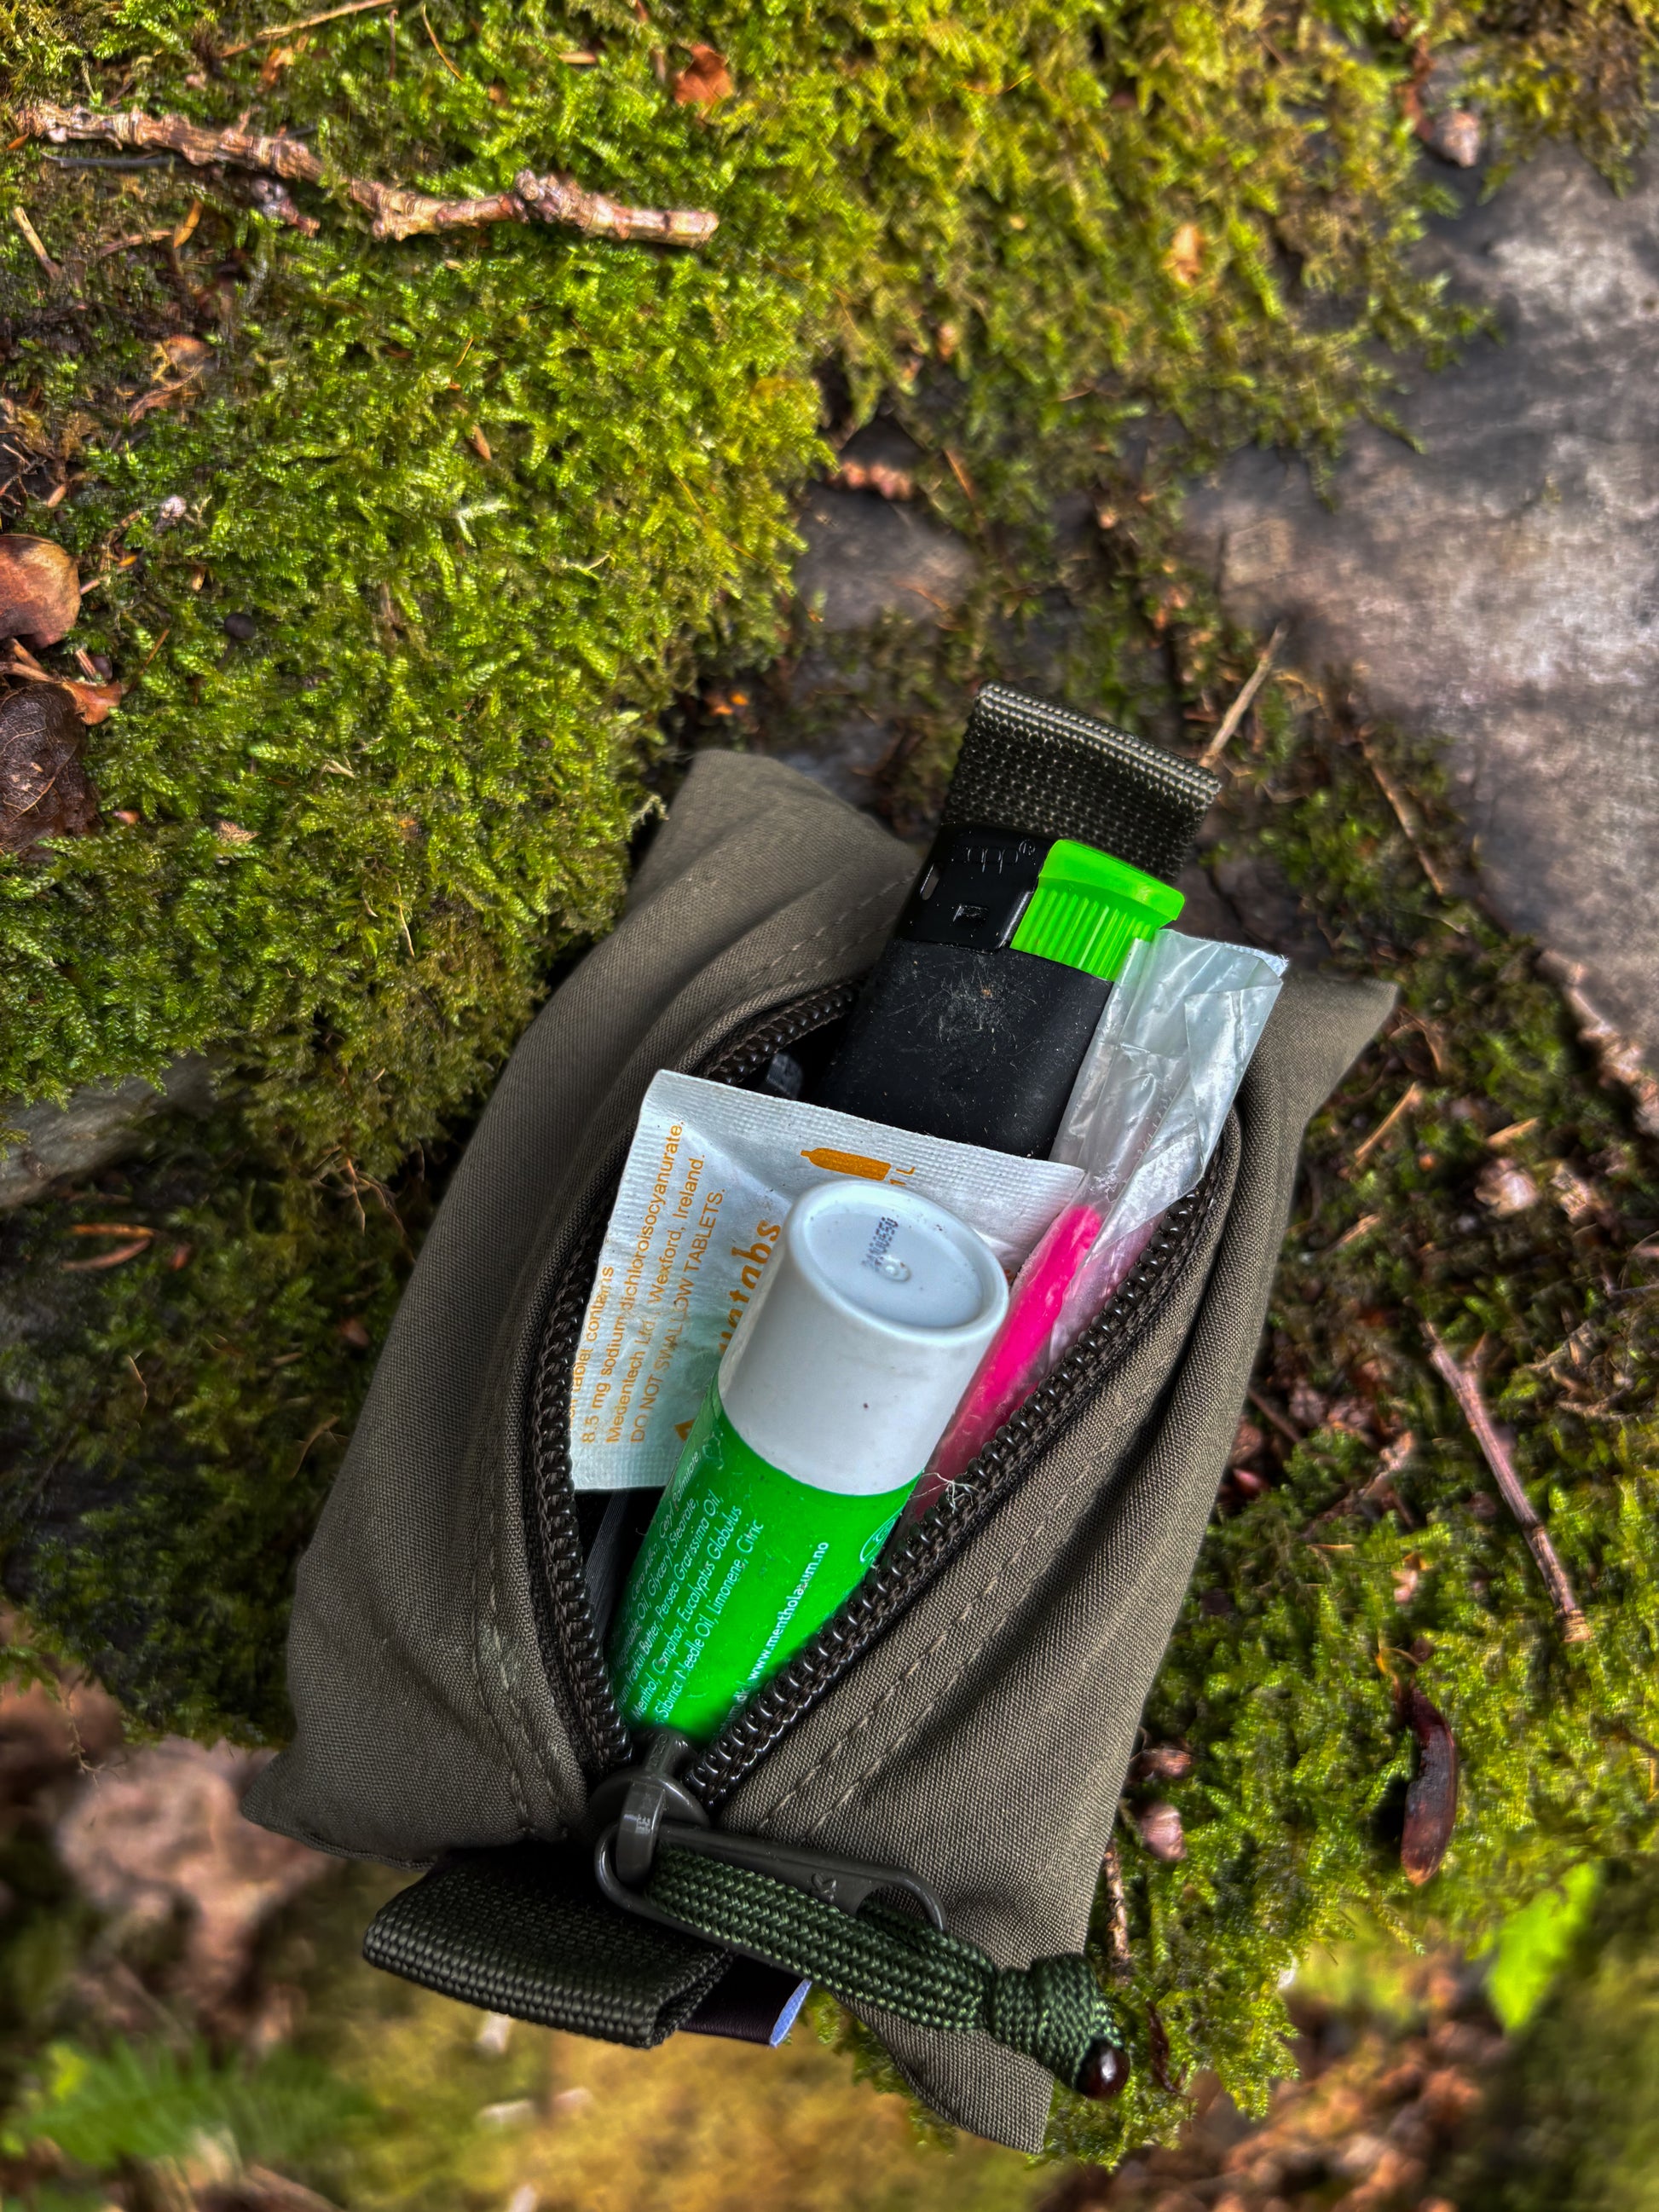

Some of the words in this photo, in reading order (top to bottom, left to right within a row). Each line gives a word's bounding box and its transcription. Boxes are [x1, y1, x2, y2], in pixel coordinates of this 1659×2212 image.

[620, 1120, 686, 1311] dichloroisocyanurate.
[600, 1315, 627, 1376] sodium
[605, 1351, 645, 1443] Medentech
[648, 1227, 685, 1302] Wexford,
[672, 1152, 707, 1219] Ireland.
[630, 1413, 648, 1443] DO
[639, 1375, 662, 1410] NOT
[653, 1278, 695, 1370] SWALLOW
[683, 1186, 726, 1273] TABLETS.
[581, 1414, 599, 1444] 8.5
[591, 1383, 611, 1409] mg
[625, 1651, 646, 1685] Parkii
[639, 1620, 663, 1655] Butter,
[656, 1581, 679, 1620] Persea
[674, 1517, 709, 1581] Gratissima
[703, 1488, 724, 1516] Oil,
[632, 1672, 662, 1720] Menthol,
[677, 1561, 714, 1622] Eucalyptus
[707, 1505, 743, 1561] Globulus
[638, 1597, 651, 1620] Oil,
[648, 1541, 677, 1597] Glyceryl
[666, 1498, 699, 1549] Stearate,
[695, 1614, 719, 1637] Oil,
[708, 1559, 749, 1615] Limonene,
[737, 1519, 764, 1554] Citric
